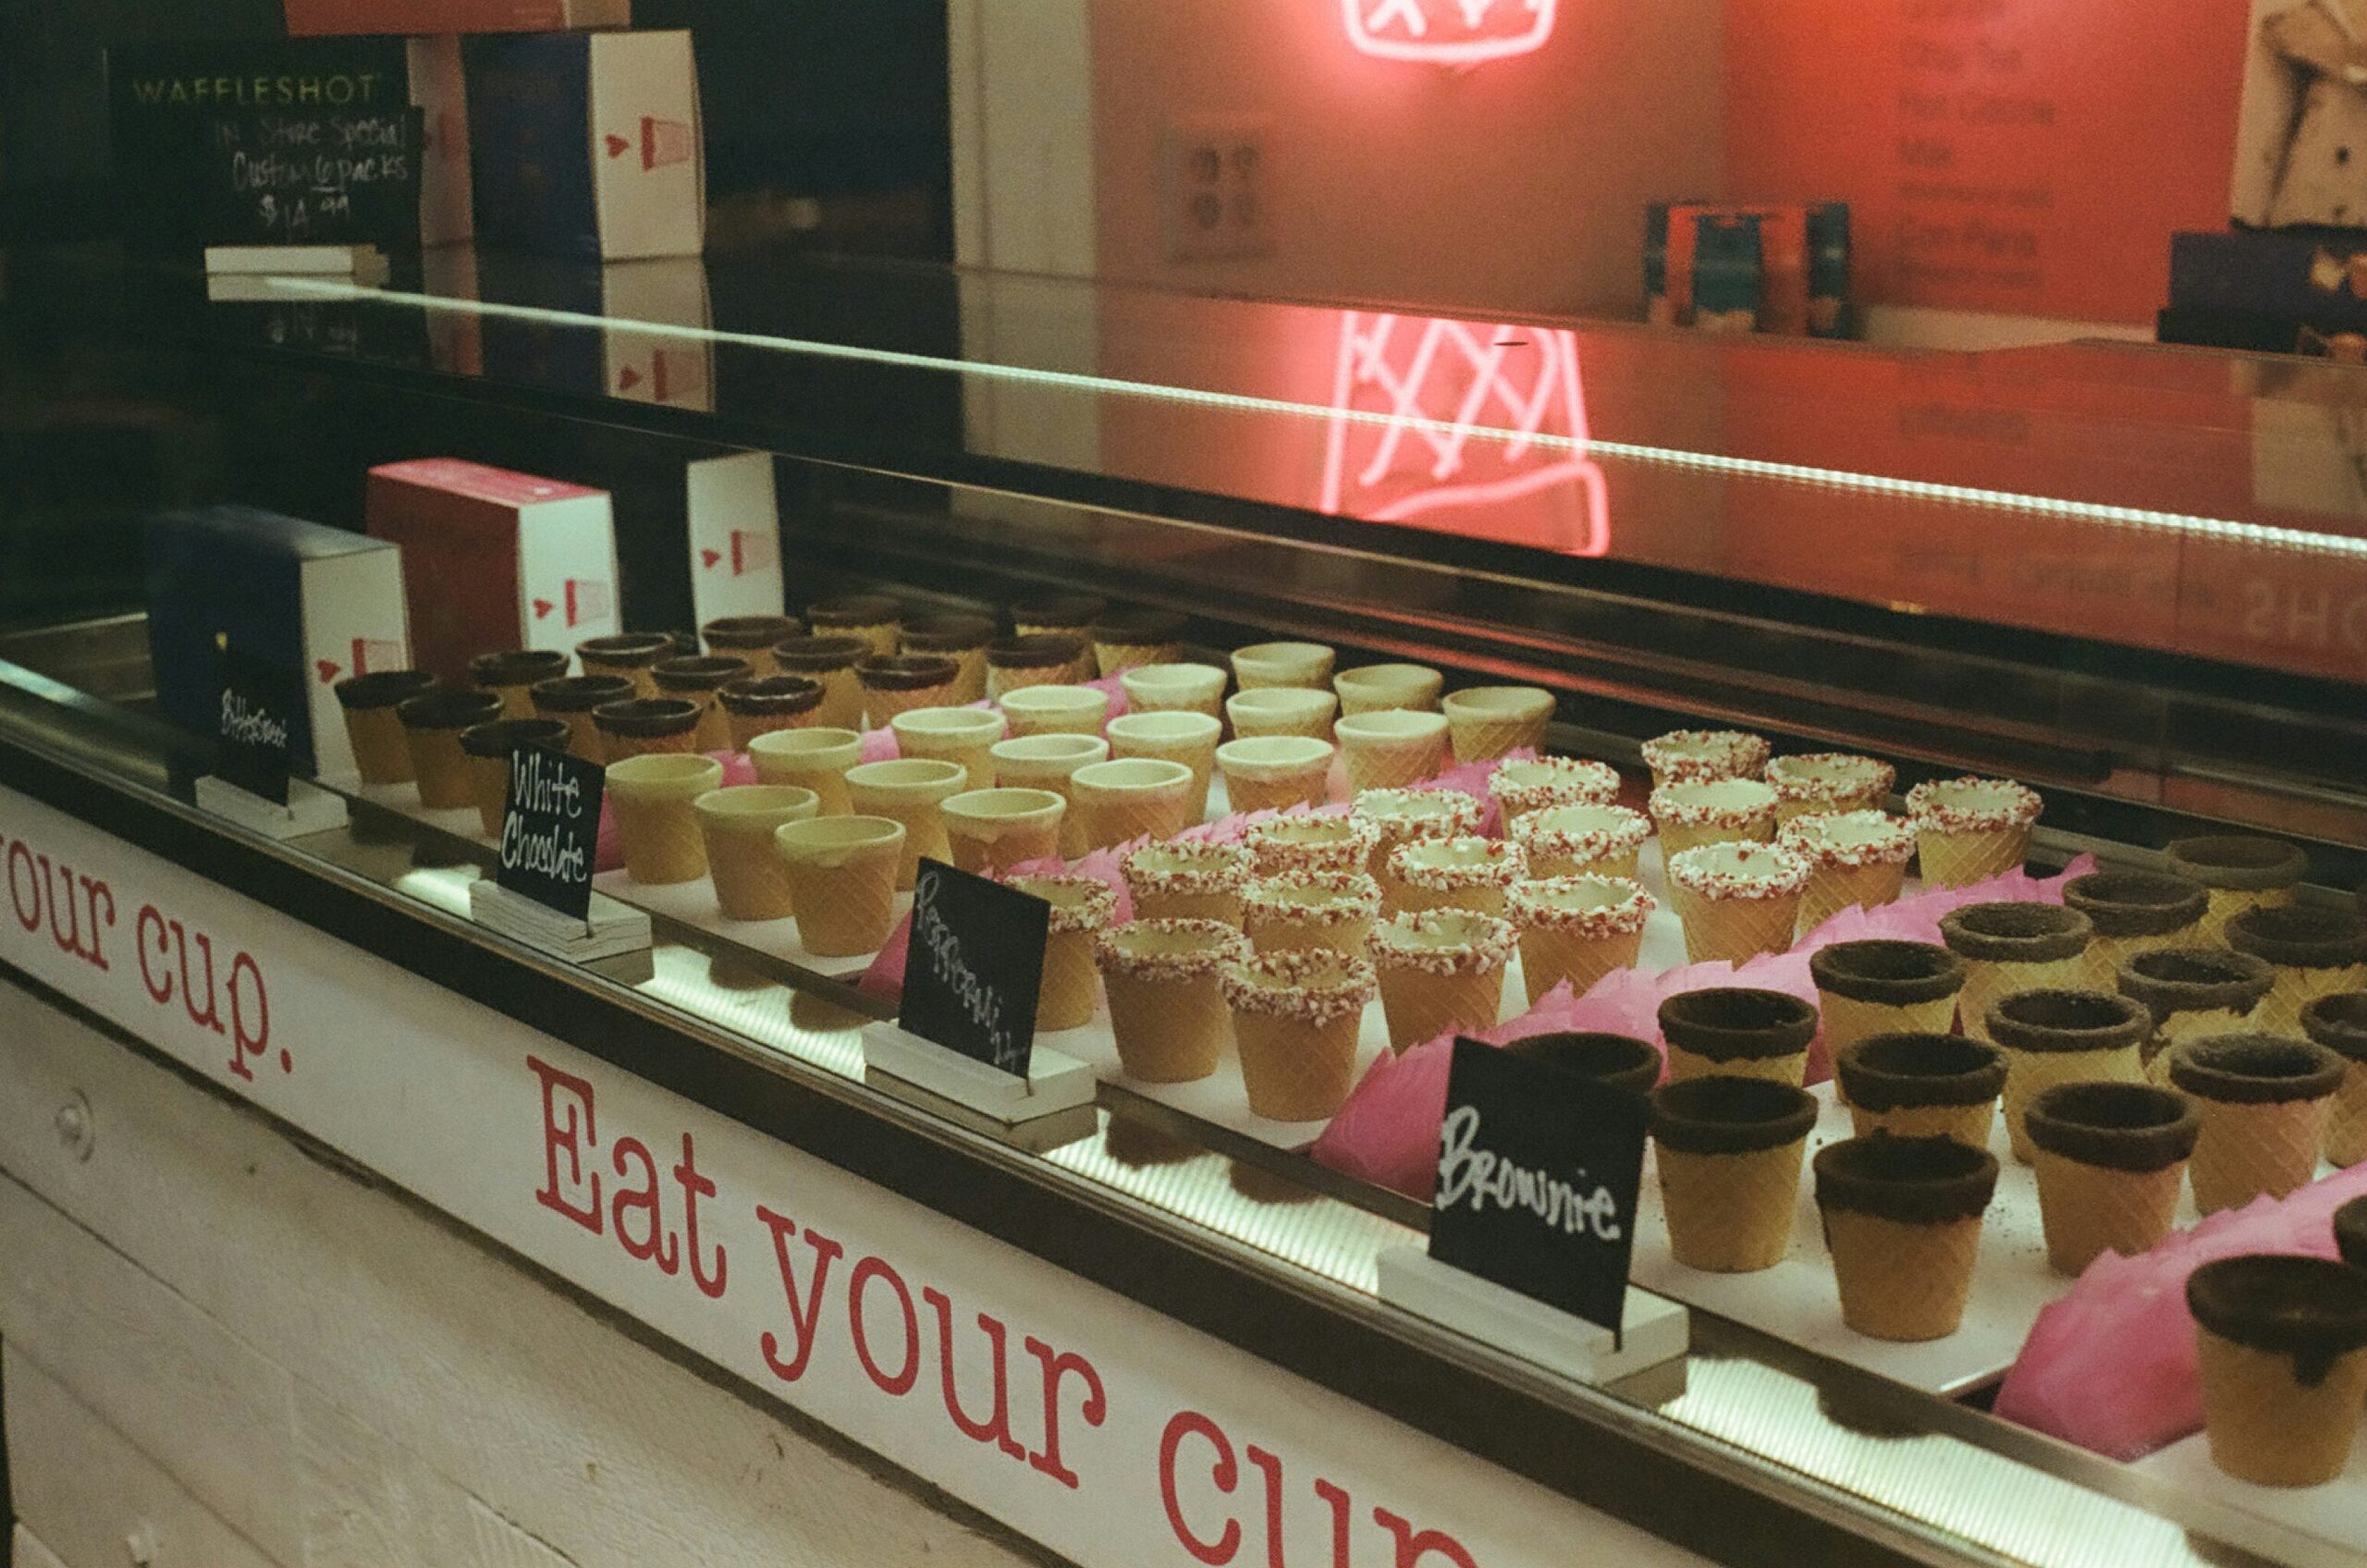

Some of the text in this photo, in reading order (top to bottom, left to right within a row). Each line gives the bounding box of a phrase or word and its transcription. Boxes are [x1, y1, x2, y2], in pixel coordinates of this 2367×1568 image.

[132, 74, 375, 105] WAFFLESHOT
[513, 749, 582, 819] White
[500, 811, 587, 883] Chocolate
[0, 834, 116, 971] our
[136, 903, 293, 1083] cup.
[526, 1054, 728, 1299] Eat
[755, 1204, 1107, 1490] your
